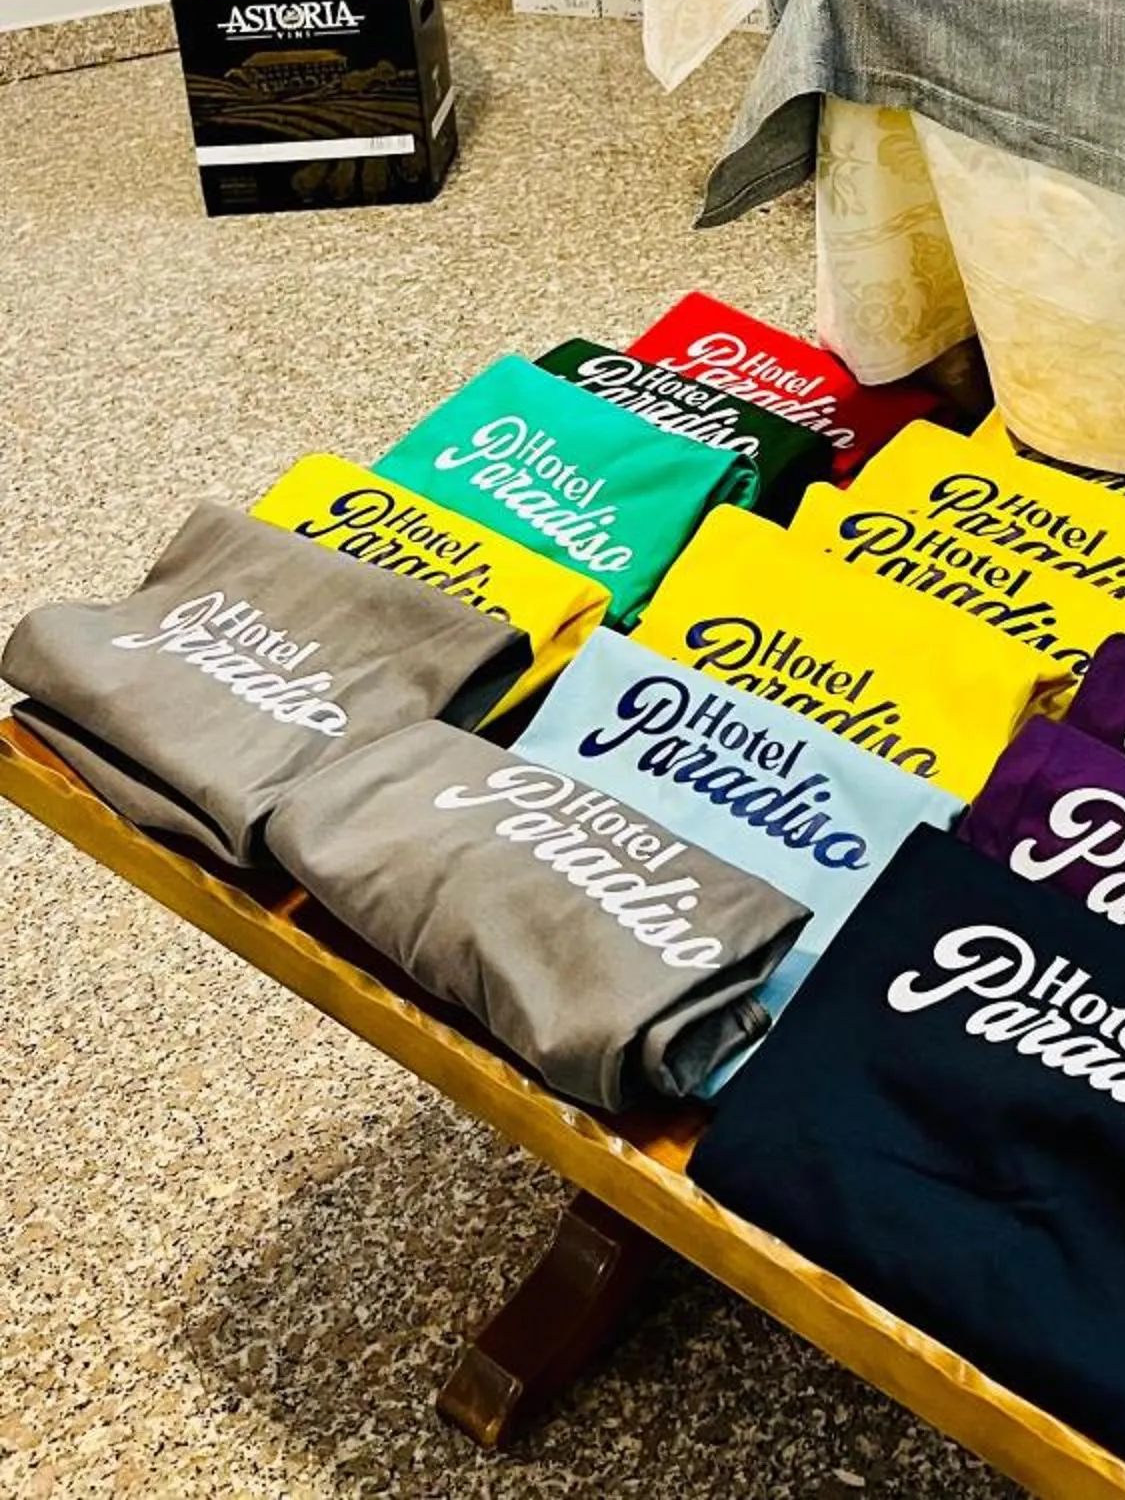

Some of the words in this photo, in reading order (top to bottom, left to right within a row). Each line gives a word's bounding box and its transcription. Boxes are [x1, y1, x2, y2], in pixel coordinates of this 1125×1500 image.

[217, 0, 366, 35] ASTORIA
[636, 366, 719, 412] Hotel
[738, 352, 827, 398] Hotel
[435, 414, 638, 574] Paradiso
[521, 428, 607, 509] Hotel
[383, 506, 483, 566] Hotel
[913, 531, 1033, 598] Hotel
[1000, 494, 1108, 558] Hotel
[113, 591, 353, 740] Paradiso
[209, 599, 322, 676] Hotel
[760, 629, 875, 704] Hotel
[580, 676, 872, 871] Paradiso
[684, 693, 809, 781] Hotel
[435, 764, 722, 970] Paradiso
[560, 787, 691, 874] Hotel
